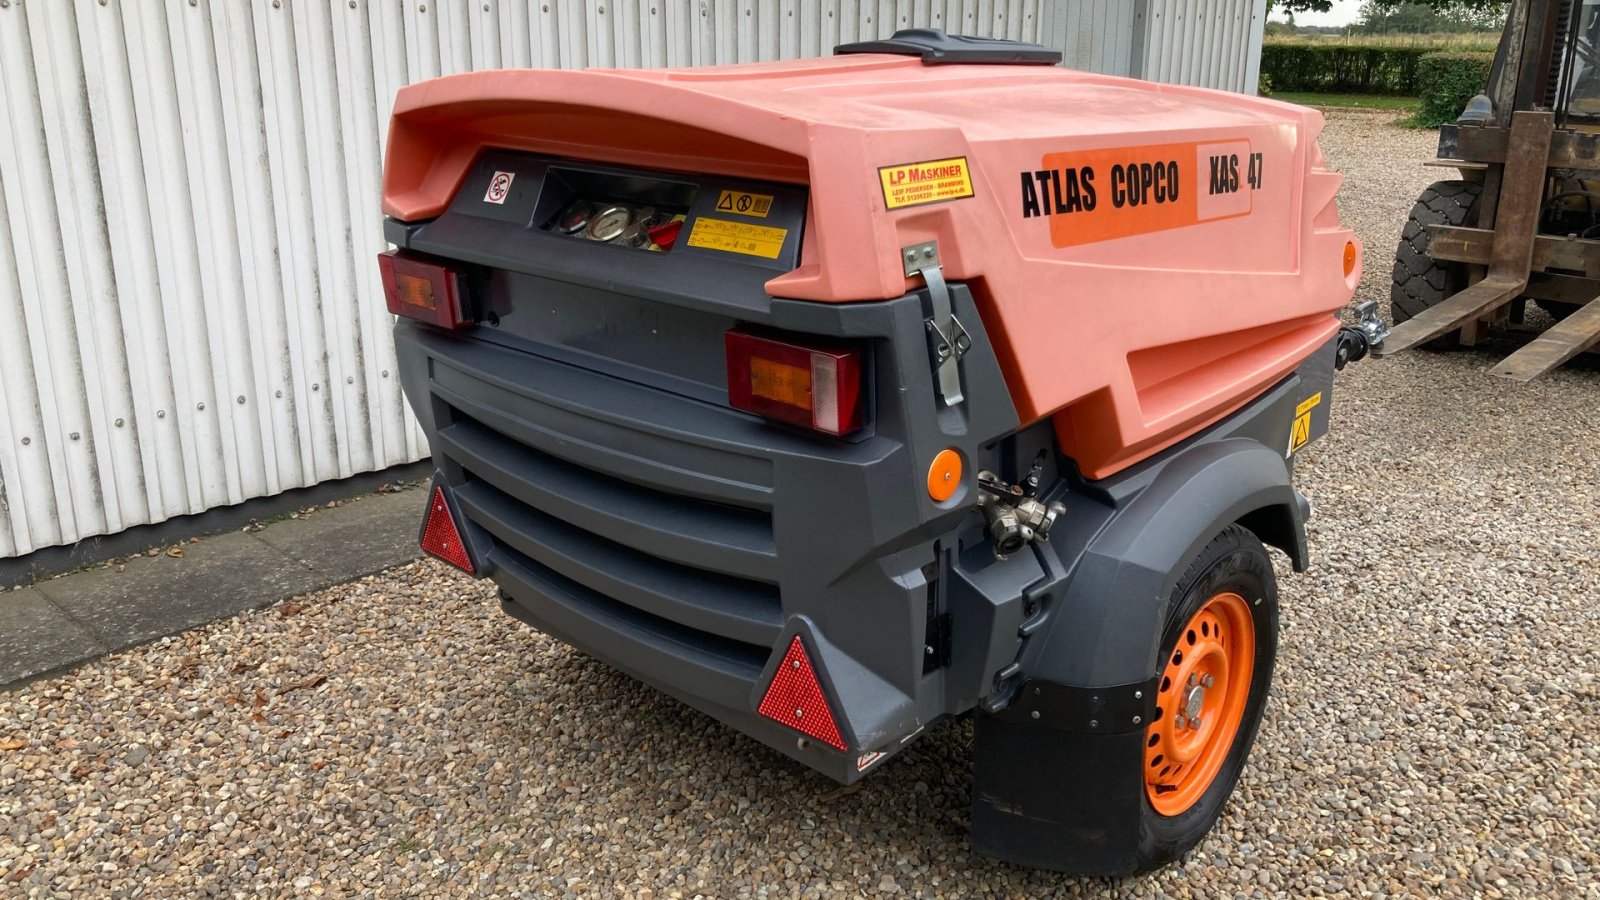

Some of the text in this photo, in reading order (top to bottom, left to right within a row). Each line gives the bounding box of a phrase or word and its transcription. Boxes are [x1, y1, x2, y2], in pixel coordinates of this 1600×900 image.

[889, 164, 962, 186] LP MASKINER
[1020, 152, 1263, 219] ATLAS COPCO XAS 47
